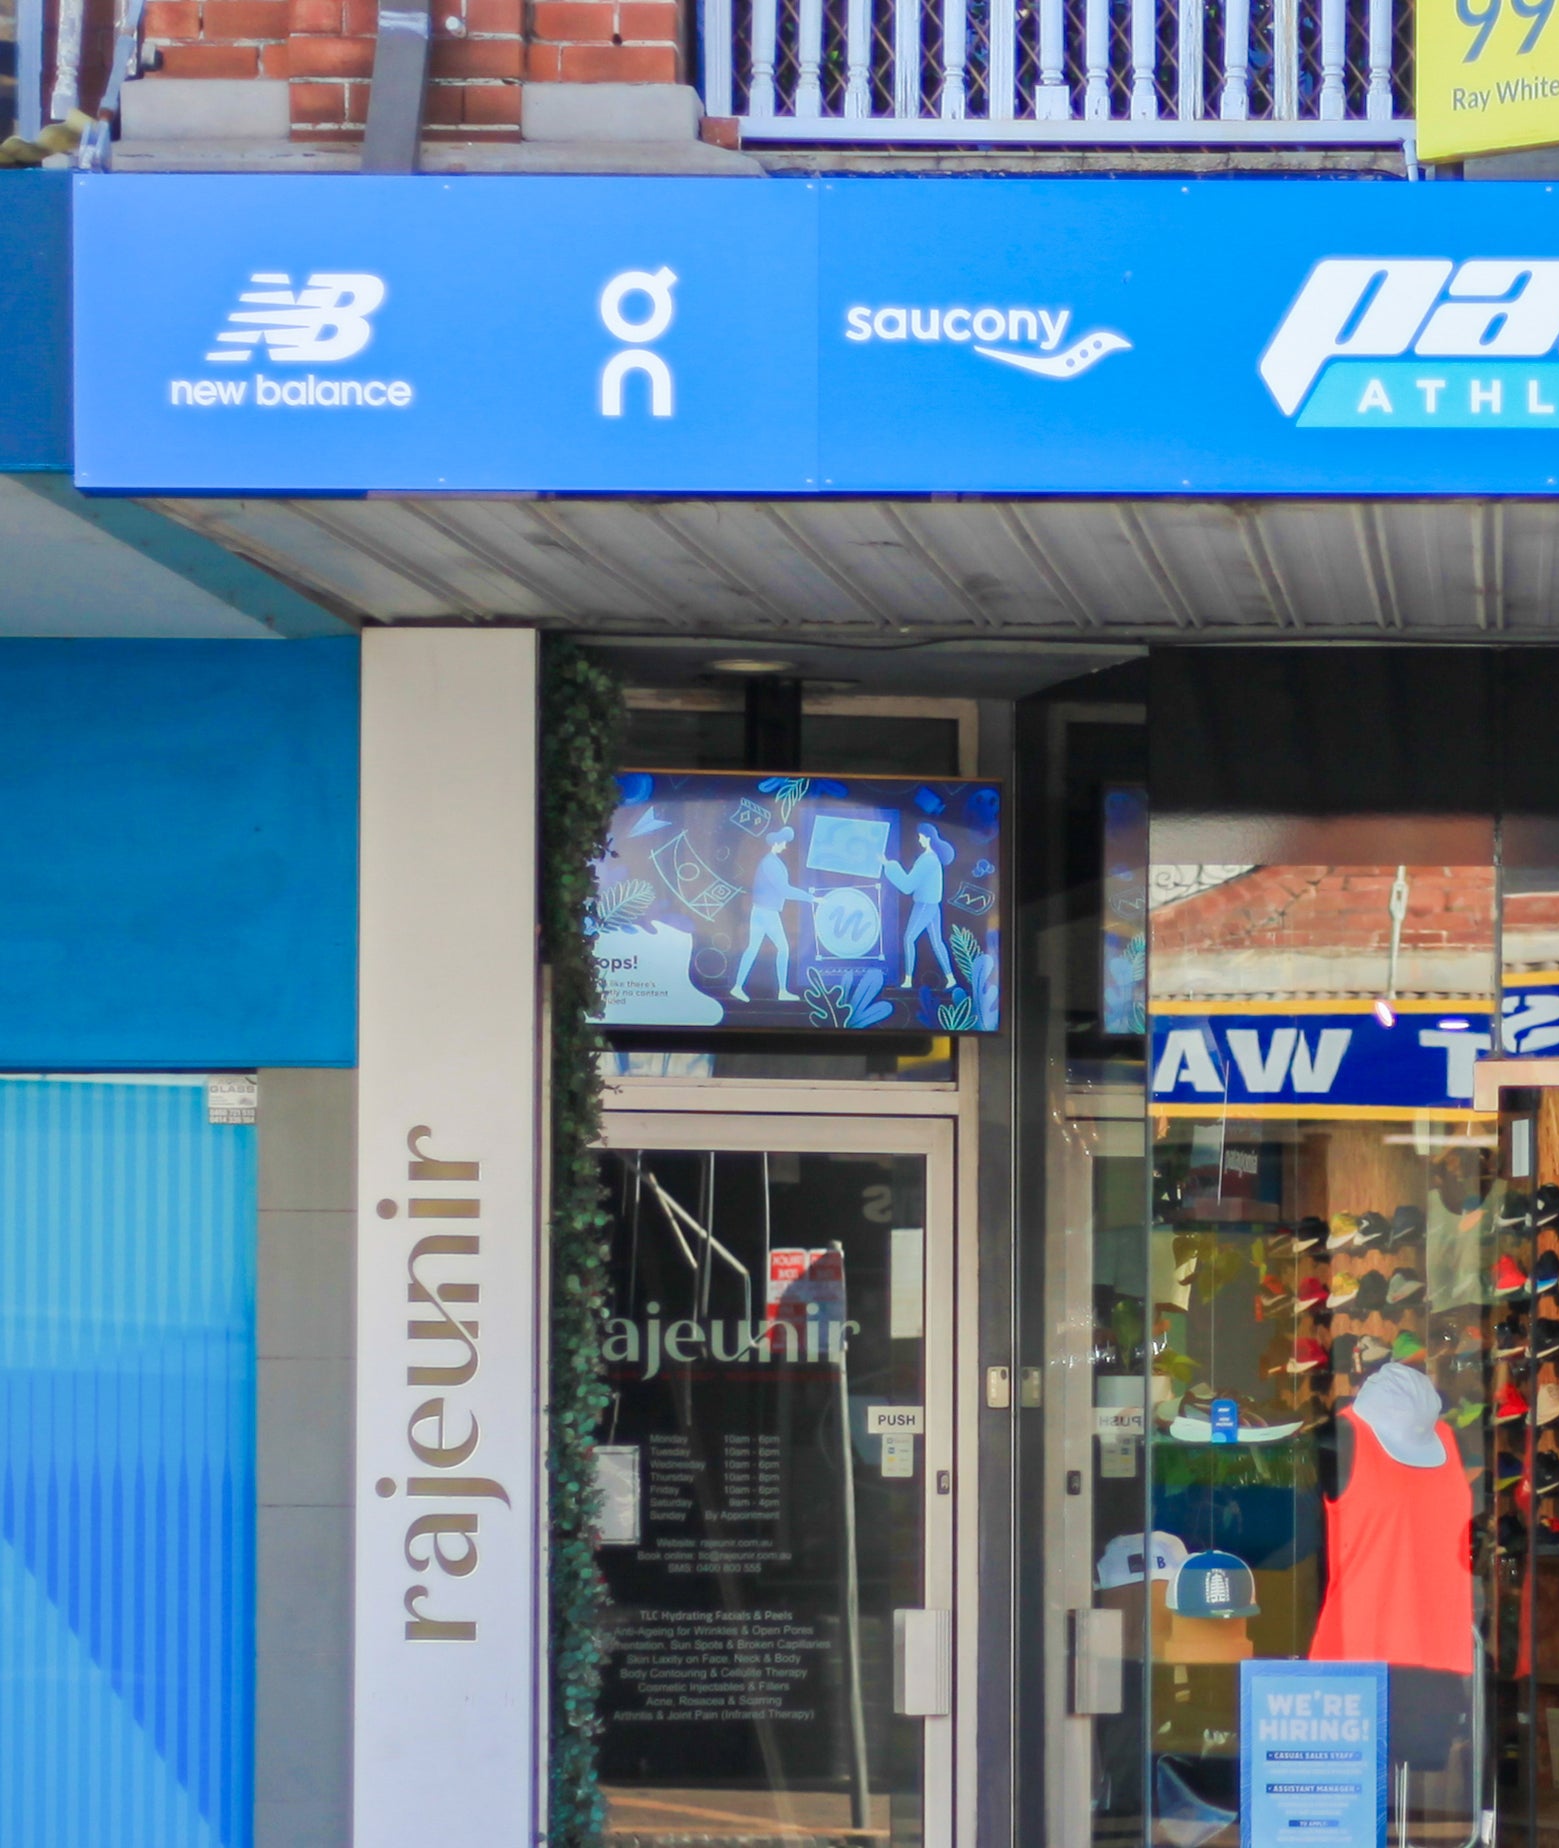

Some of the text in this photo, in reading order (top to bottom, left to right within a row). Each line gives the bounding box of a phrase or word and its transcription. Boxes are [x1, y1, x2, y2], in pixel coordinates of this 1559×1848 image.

[1452, 88, 1491, 112] Ray
[845, 306, 1070, 350] saucony
[170, 374, 412, 407] new balance
[375, 1124, 512, 1642] rajeunir
[878, 1414, 916, 1426] PUSH
[650, 1435, 688, 1444] Monday
[651, 1448, 690, 1457] Tuesday
[650, 1461, 706, 1471] Wednesday
[651, 1474, 694, 1483] Thursday
[650, 1486, 679, 1496] Friday
[650, 1499, 692, 1508] Saturday
[650, 1511, 780, 1521] Sunday By Appointment
[637, 1552, 661, 1560] Book
[661, 1611, 713, 1623] Hydrating
[715, 1610, 751, 1620] Facials
[753, 1611, 761, 1620] &
[764, 1610, 793, 1620] Peels
[677, 1626, 690, 1635] for
[694, 1626, 738, 1635] Wrinkles
[740, 1626, 749, 1635] &
[752, 1626, 781, 1637] Open
[783, 1625, 814, 1635] Pores
[670, 1640, 692, 1649] Sun
[695, 1640, 723, 1652] Spots
[727, 1640, 735, 1649] &
[737, 1639, 774, 1649] Broken
[777, 1639, 830, 1651] Capillaries
[627, 1655, 650, 1664] Skin
[652, 1654, 682, 1666] Laxity
[685, 1656, 698, 1664] on
[734, 1653, 760, 1663] Neck
[764, 1653, 771, 1663] &
[774, 1653, 801, 1665] Body
[620, 1668, 808, 1680] Body Contouring & Cellulite Therapy
[638, 1681, 790, 1693] Cosmetic Injectables & Fillers
[679, 1696, 724, 1706] Rosacea
[727, 1696, 735, 1706] &
[1266, 1689, 1362, 1717] WE'RE
[614, 1710, 814, 1722] Arthritis & Joint Pain (Infrared Therapy)
[1258, 1718, 1370, 1742] HIRING!
[1274, 1752, 1303, 1760] CASUAL
[1272, 1785, 1314, 1793] ASSISTANT
